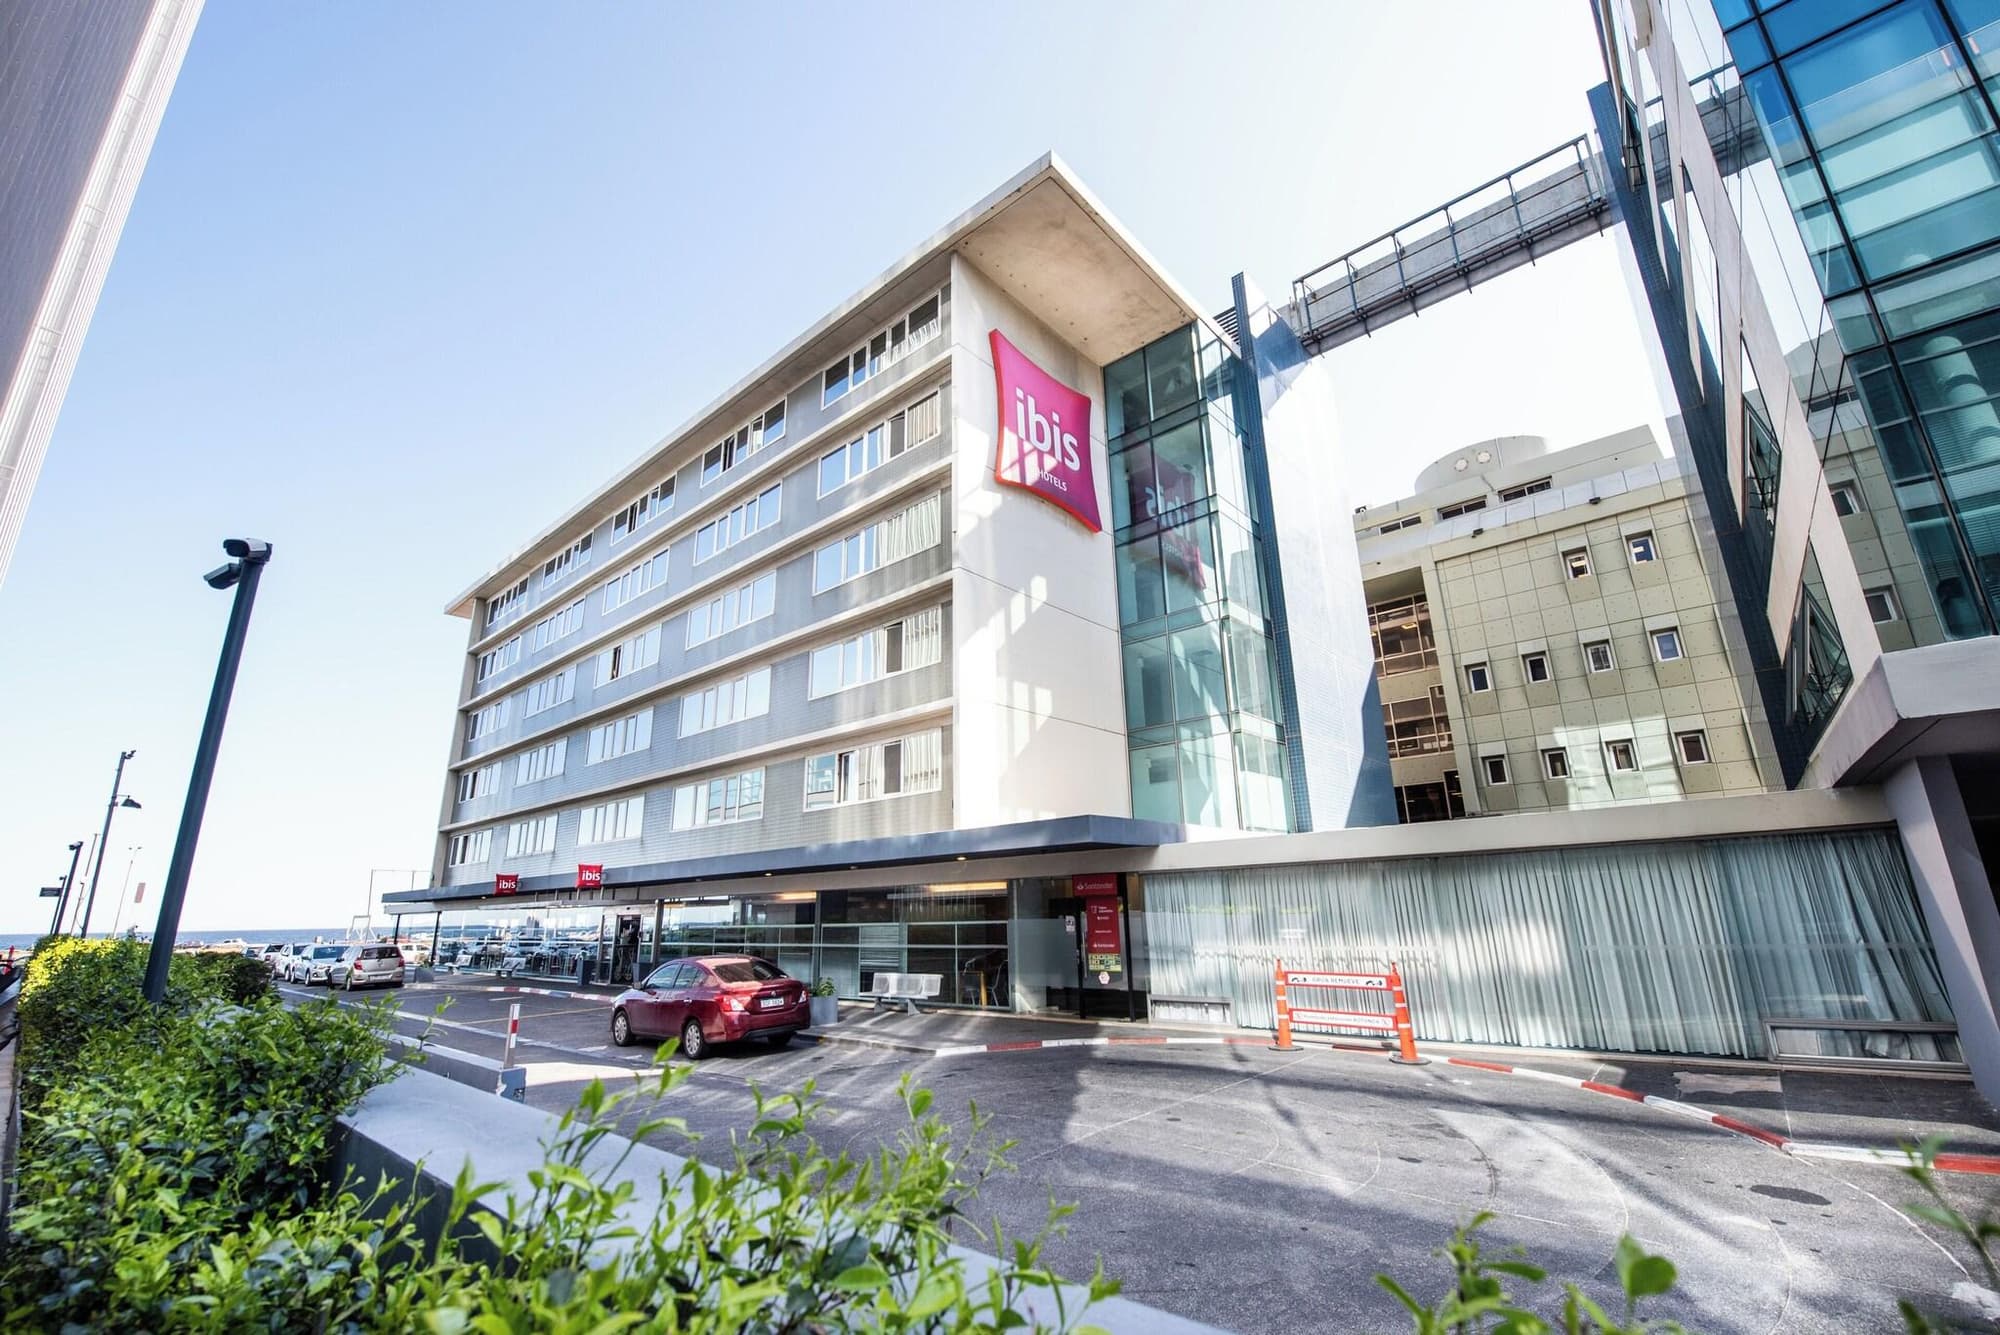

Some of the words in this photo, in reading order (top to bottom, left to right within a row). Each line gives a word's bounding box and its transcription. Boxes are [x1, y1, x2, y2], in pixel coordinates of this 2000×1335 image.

[1015, 387, 1081, 471] ibis
[1039, 468, 1068, 492] HOTELS
[499, 879, 516, 889] ibis
[582, 870, 600, 881] ibis
